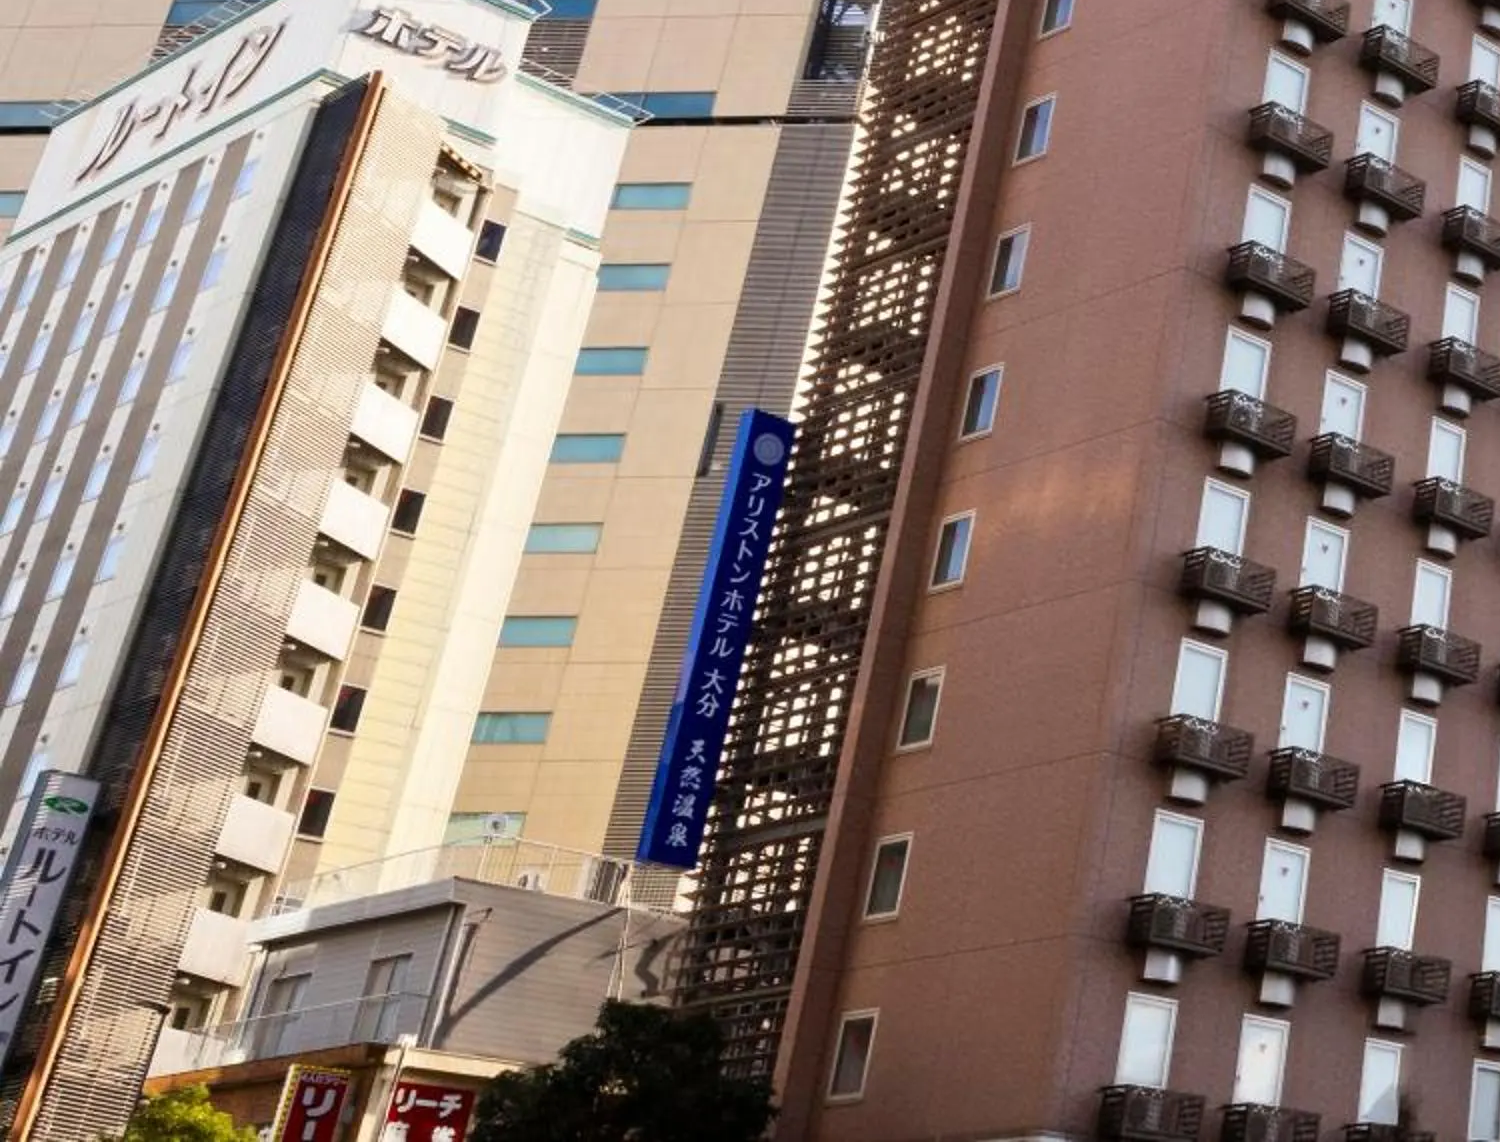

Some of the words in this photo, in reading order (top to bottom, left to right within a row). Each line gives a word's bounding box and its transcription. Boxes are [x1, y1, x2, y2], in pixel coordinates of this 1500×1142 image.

[362, 5, 507, 83] ホテル
[75, 22, 287, 183] ルートイン
[32, 826, 78, 846] ホテル
[395, 1087, 462, 1118] リーチ
